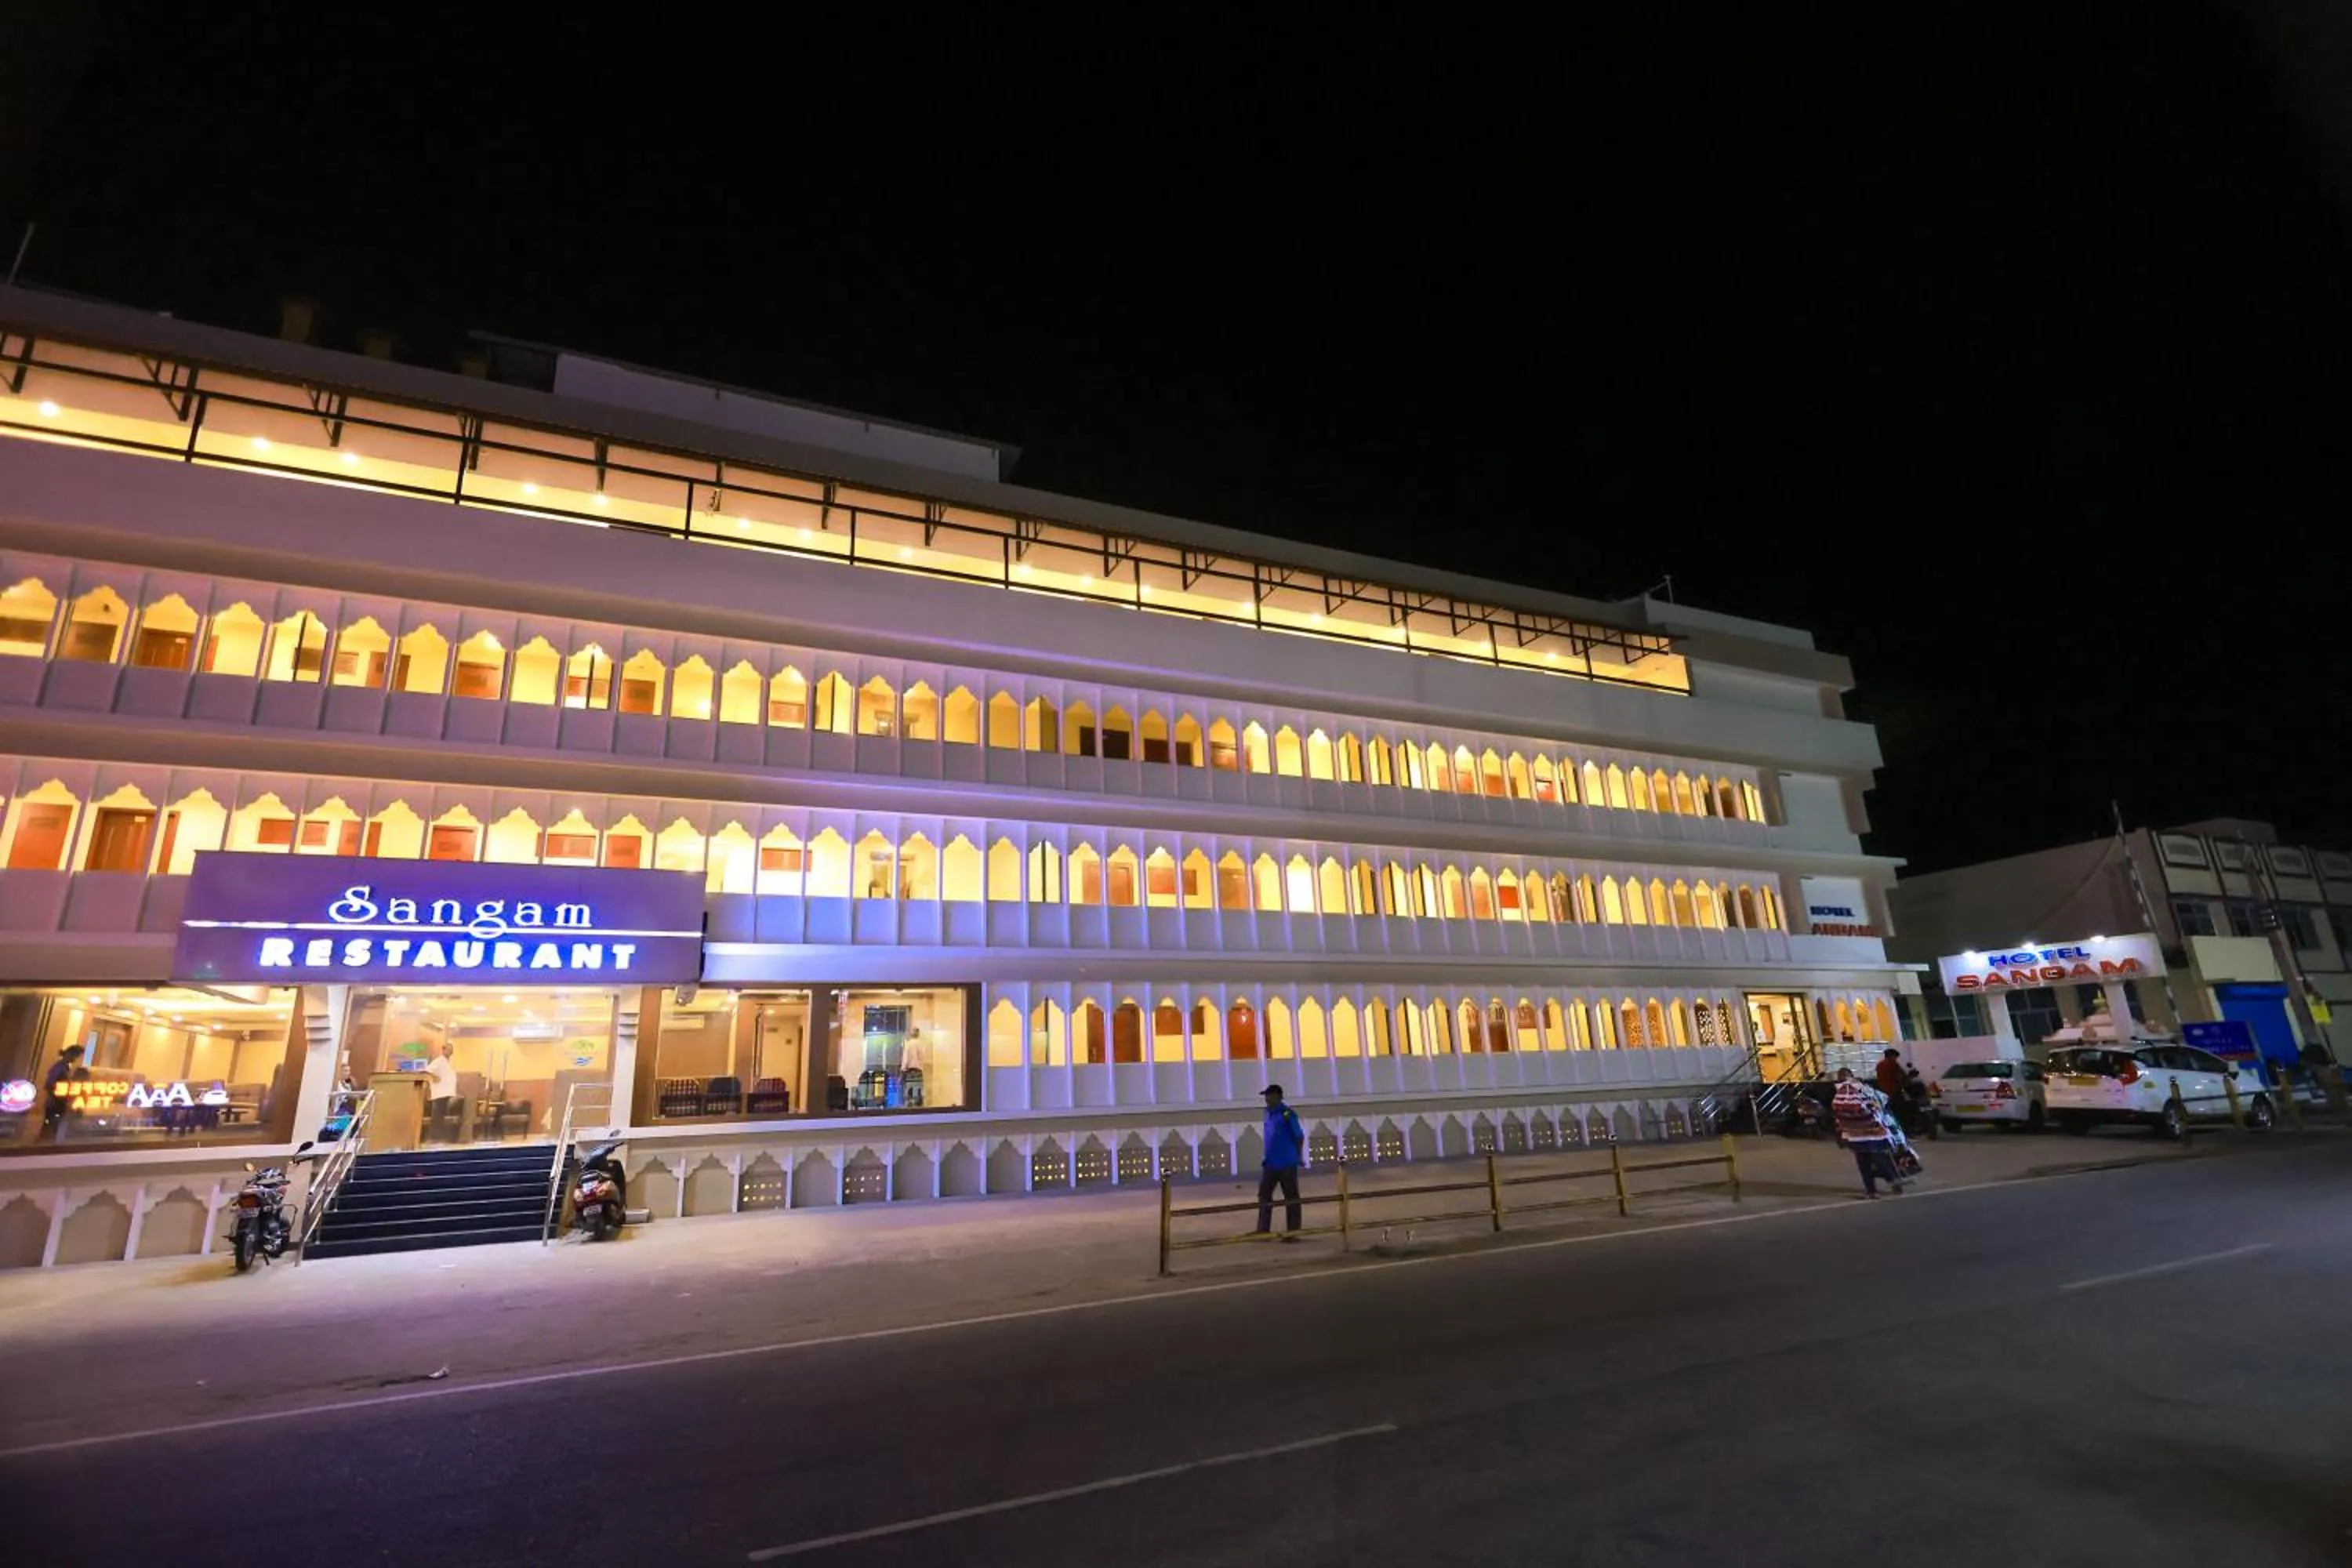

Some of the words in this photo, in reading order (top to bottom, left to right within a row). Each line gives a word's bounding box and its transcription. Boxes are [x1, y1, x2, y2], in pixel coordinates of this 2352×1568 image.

[328, 884, 593, 939] Sangam
[259, 937, 636, 971] RESTAURANT
[1987, 946, 2091, 967] HOTEL
[1955, 956, 2140, 989] SANGAM
